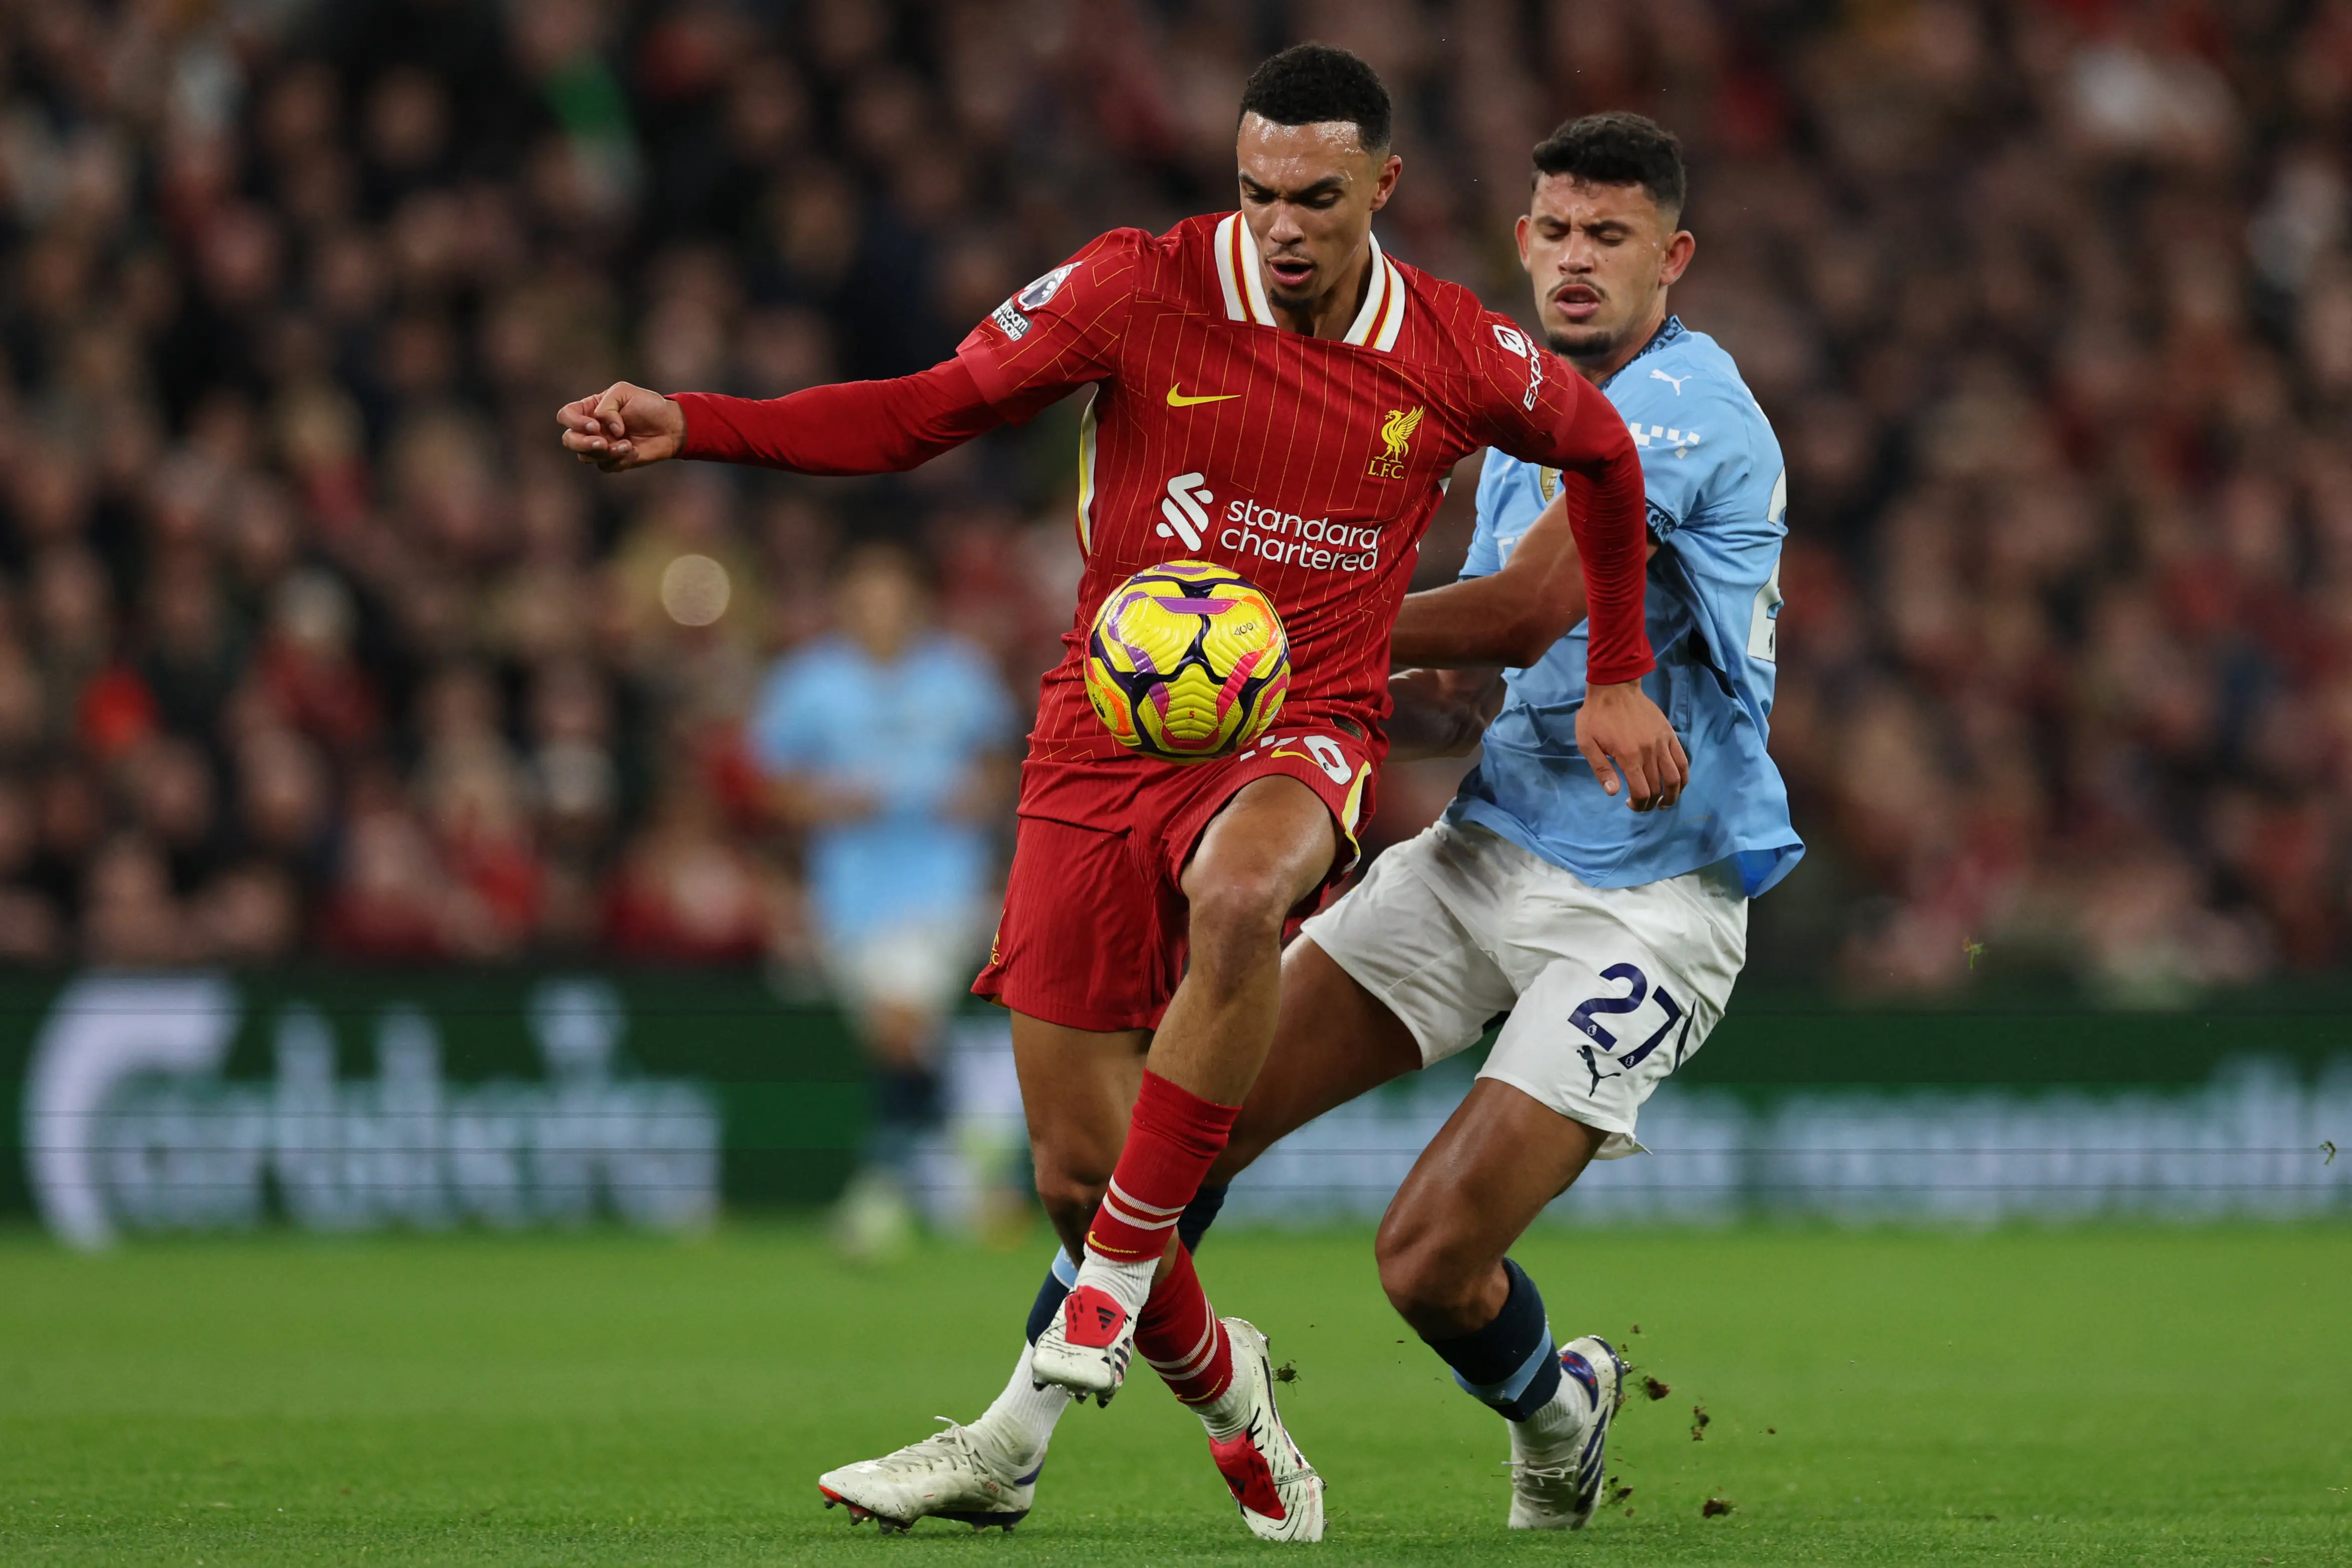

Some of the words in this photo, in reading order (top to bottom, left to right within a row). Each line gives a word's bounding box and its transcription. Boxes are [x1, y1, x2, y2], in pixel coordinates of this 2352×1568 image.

[997, 314, 1022, 341] racism
[1004, 305, 1028, 332] room
[1227, 499, 1383, 550] standard
[1221, 528, 1378, 572] chartered
[1189, 710, 1195, 719] 5
[1567, 963, 1682, 1070] 27
